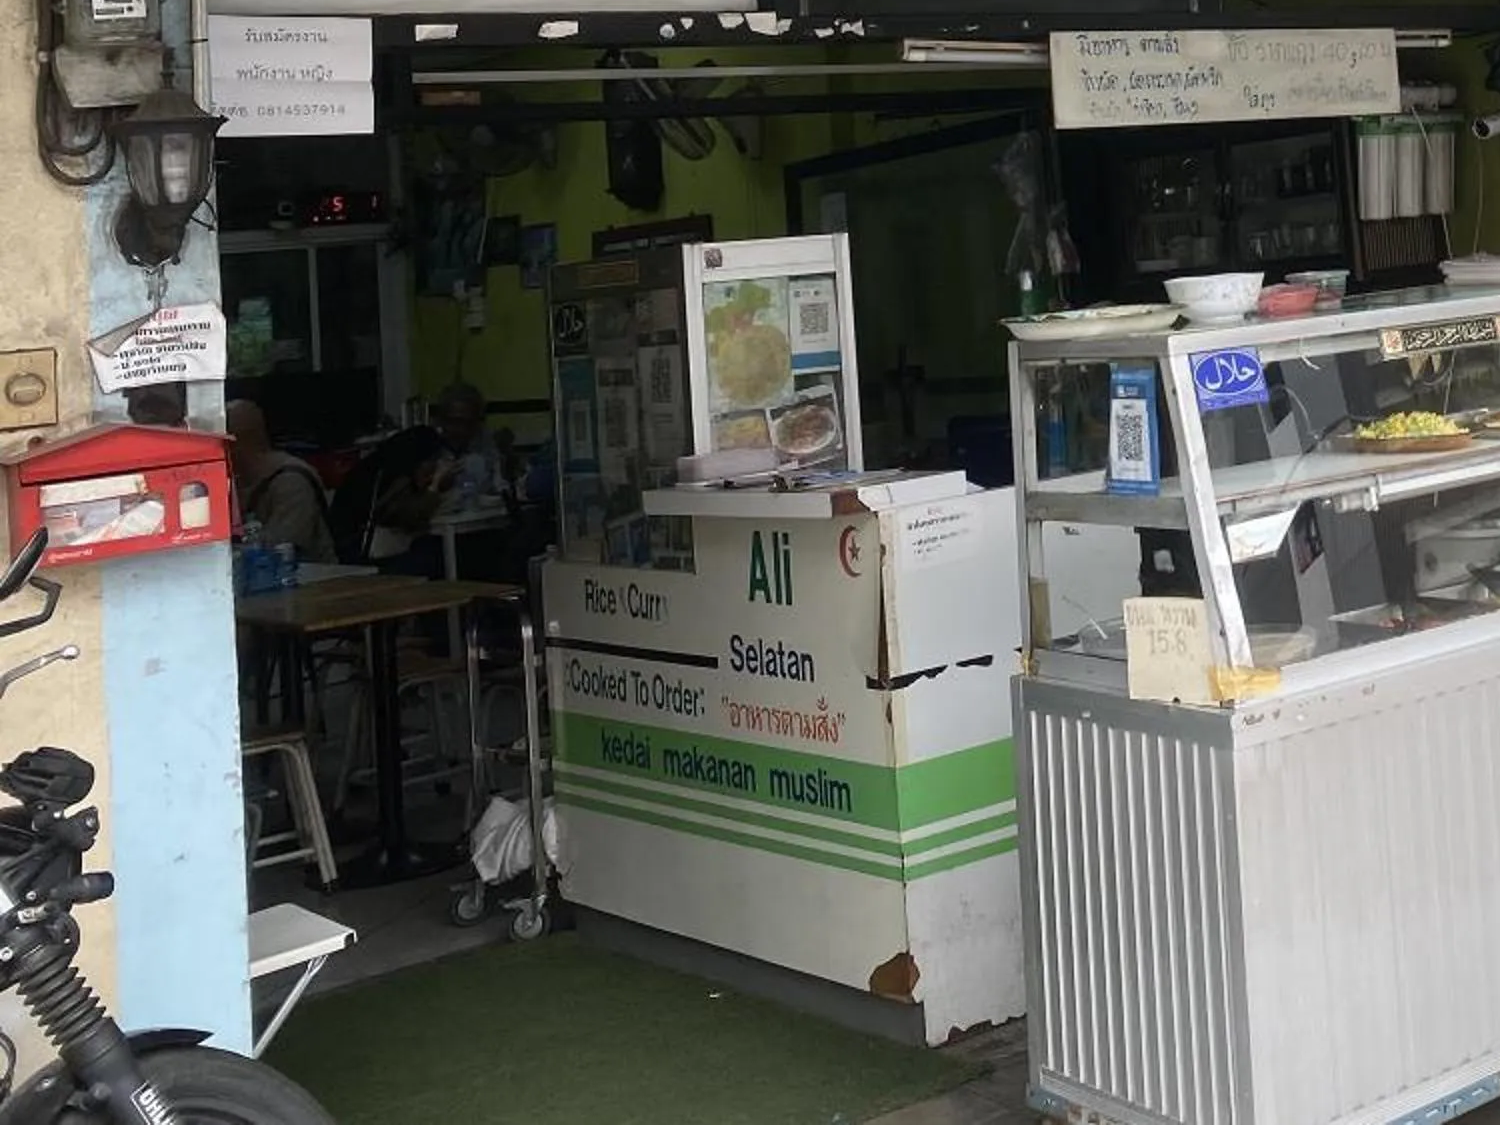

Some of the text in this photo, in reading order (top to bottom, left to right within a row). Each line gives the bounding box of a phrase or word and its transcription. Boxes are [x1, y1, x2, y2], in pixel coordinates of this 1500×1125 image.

[1205, 355, 1255, 389] حلال
[749, 530, 793, 606] Ali
[584, 579, 617, 615] Rice
[730, 635, 814, 683] Selatan
[629, 670, 649, 707] To
[601, 730, 852, 813] kedai makanan muslim
